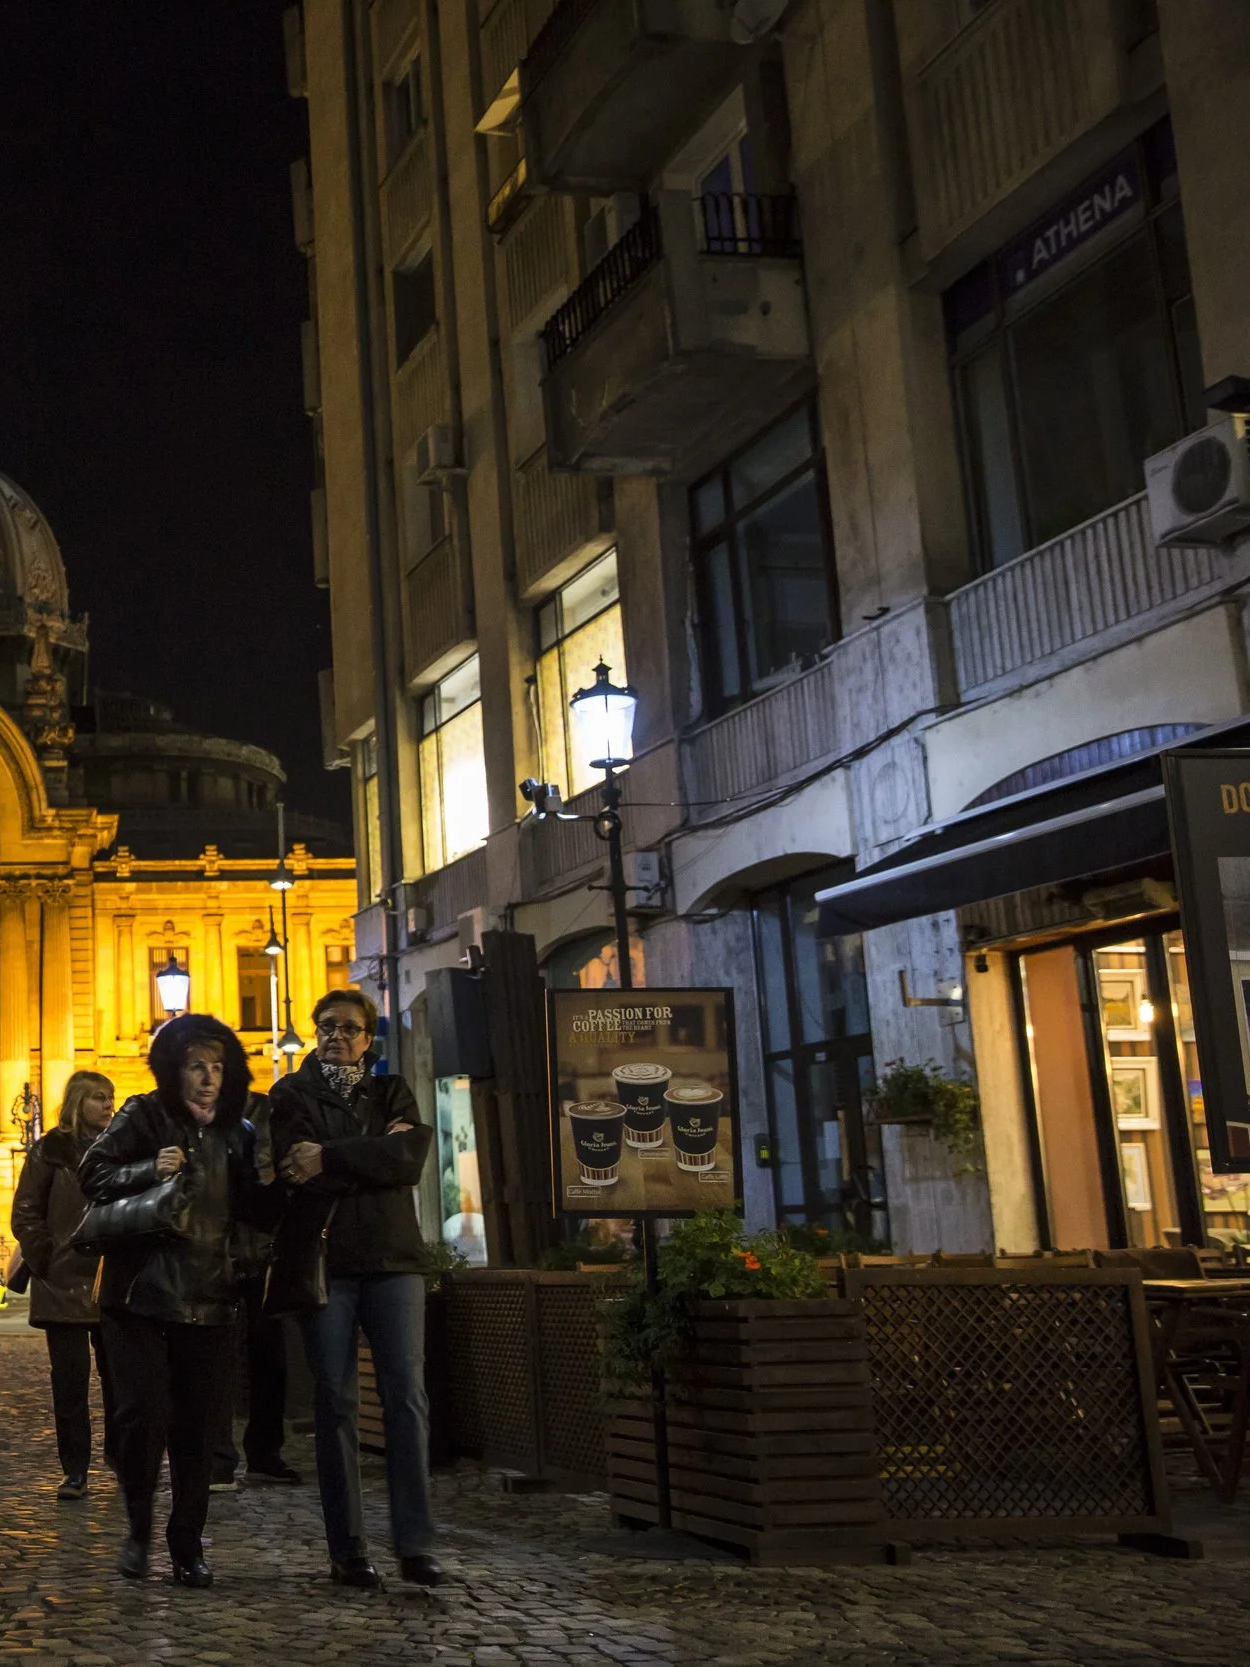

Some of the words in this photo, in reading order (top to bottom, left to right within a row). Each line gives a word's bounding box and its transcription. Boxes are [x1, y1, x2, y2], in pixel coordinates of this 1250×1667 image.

[1032, 174, 1133, 269] ATHENA
[588, 1007, 643, 1021] PASSION
[645, 1006, 673, 1019] FOR
[572, 1020, 622, 1032] COFFEE
[579, 1031, 636, 1043] QUALITY
